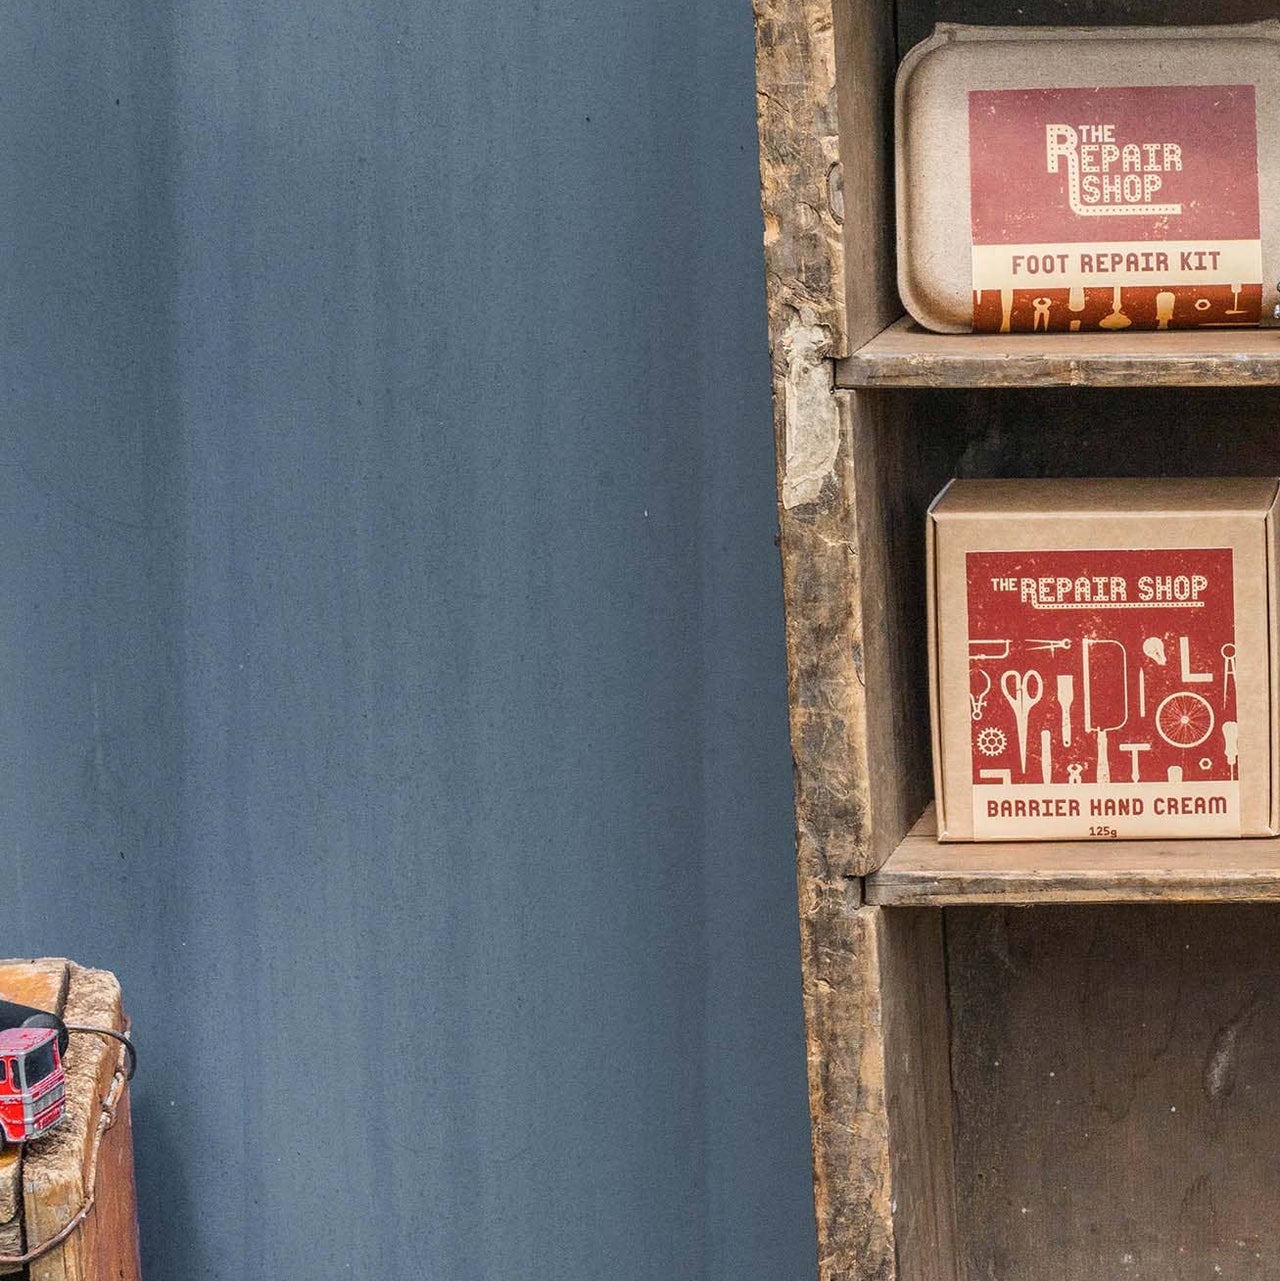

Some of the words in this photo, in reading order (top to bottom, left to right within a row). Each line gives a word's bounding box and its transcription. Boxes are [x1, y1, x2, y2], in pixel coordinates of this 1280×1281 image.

[1078, 125, 1115, 143] THE
[1046, 124, 1182, 173] REPAIR
[1081, 174, 1162, 203] SHOP
[1012, 254, 1068, 274] FOOT
[1080, 252, 1169, 272] REPAIR
[1180, 251, 1221, 271] KIT
[991, 578, 1017, 591] THE
[1020, 576, 1126, 602] REPAIR
[1138, 575, 1208, 600] SHOP
[987, 799, 1080, 817] BARRIER
[1090, 798, 1144, 816] HAND
[1153, 797, 1227, 816] CREAM
[1089, 826, 1117, 838] 125g
